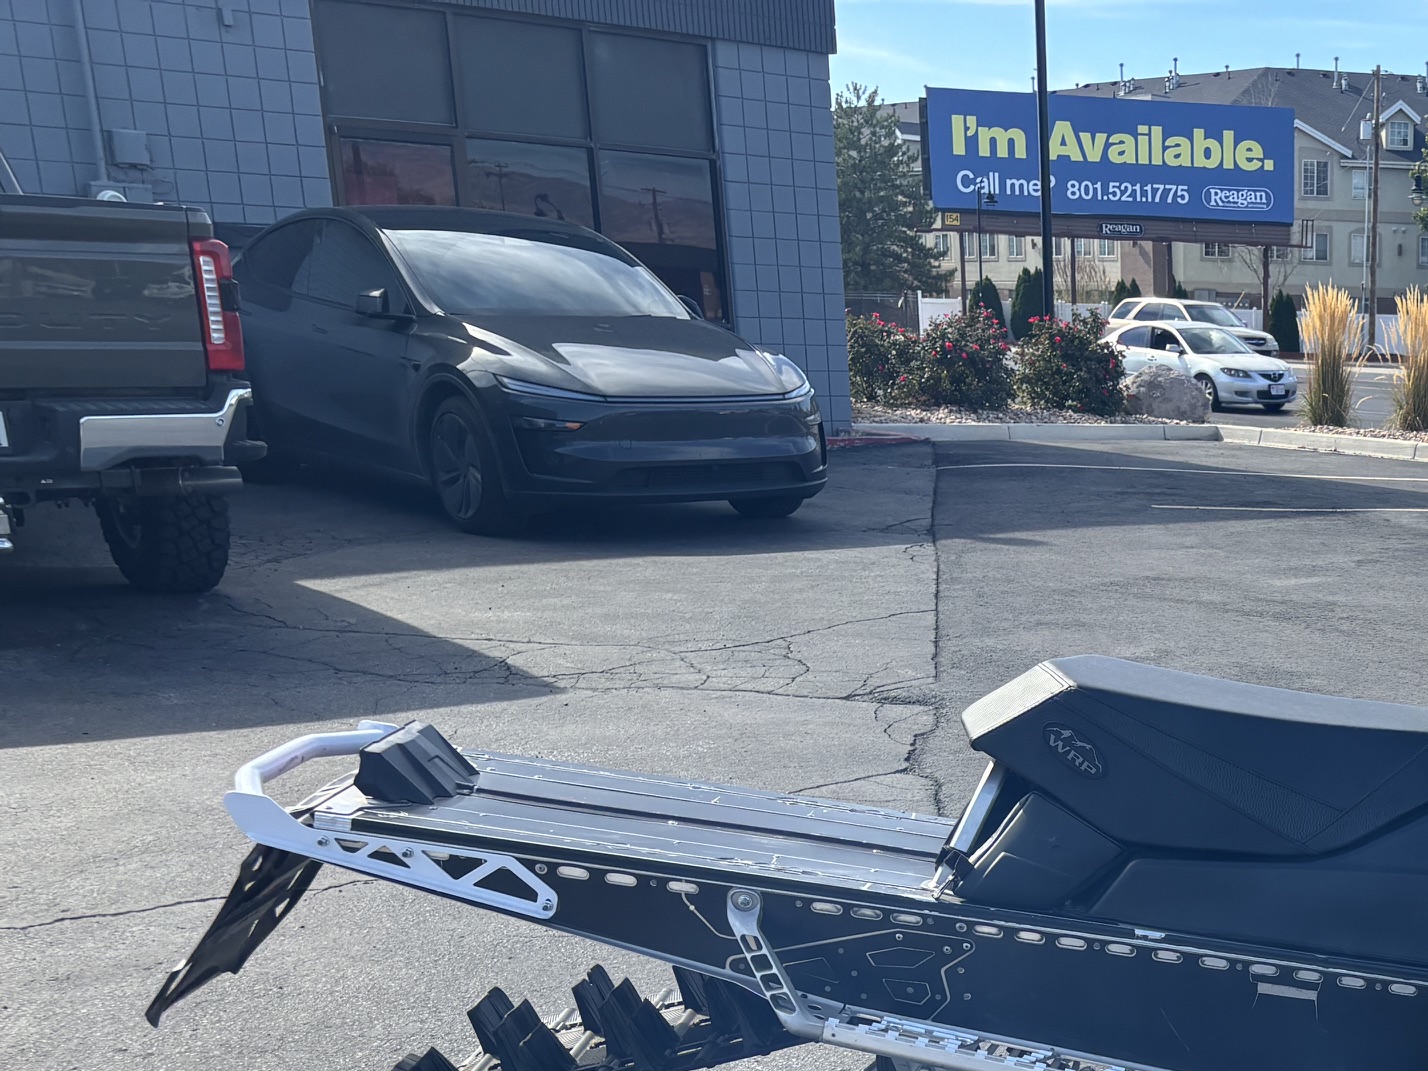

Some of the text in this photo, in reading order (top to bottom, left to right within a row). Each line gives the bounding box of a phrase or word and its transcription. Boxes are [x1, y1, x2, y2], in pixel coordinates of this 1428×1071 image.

[951, 114, 1274, 171] I'm Available.
[956, 169, 1000, 195] Call
[1066, 180, 1190, 204] 801.521.1775
[1208, 187, 1267, 208] Reagan
[945, 213, 960, 225] 154
[1101, 222, 1141, 235] Reagan
[1049, 733, 1097, 775] WRP
